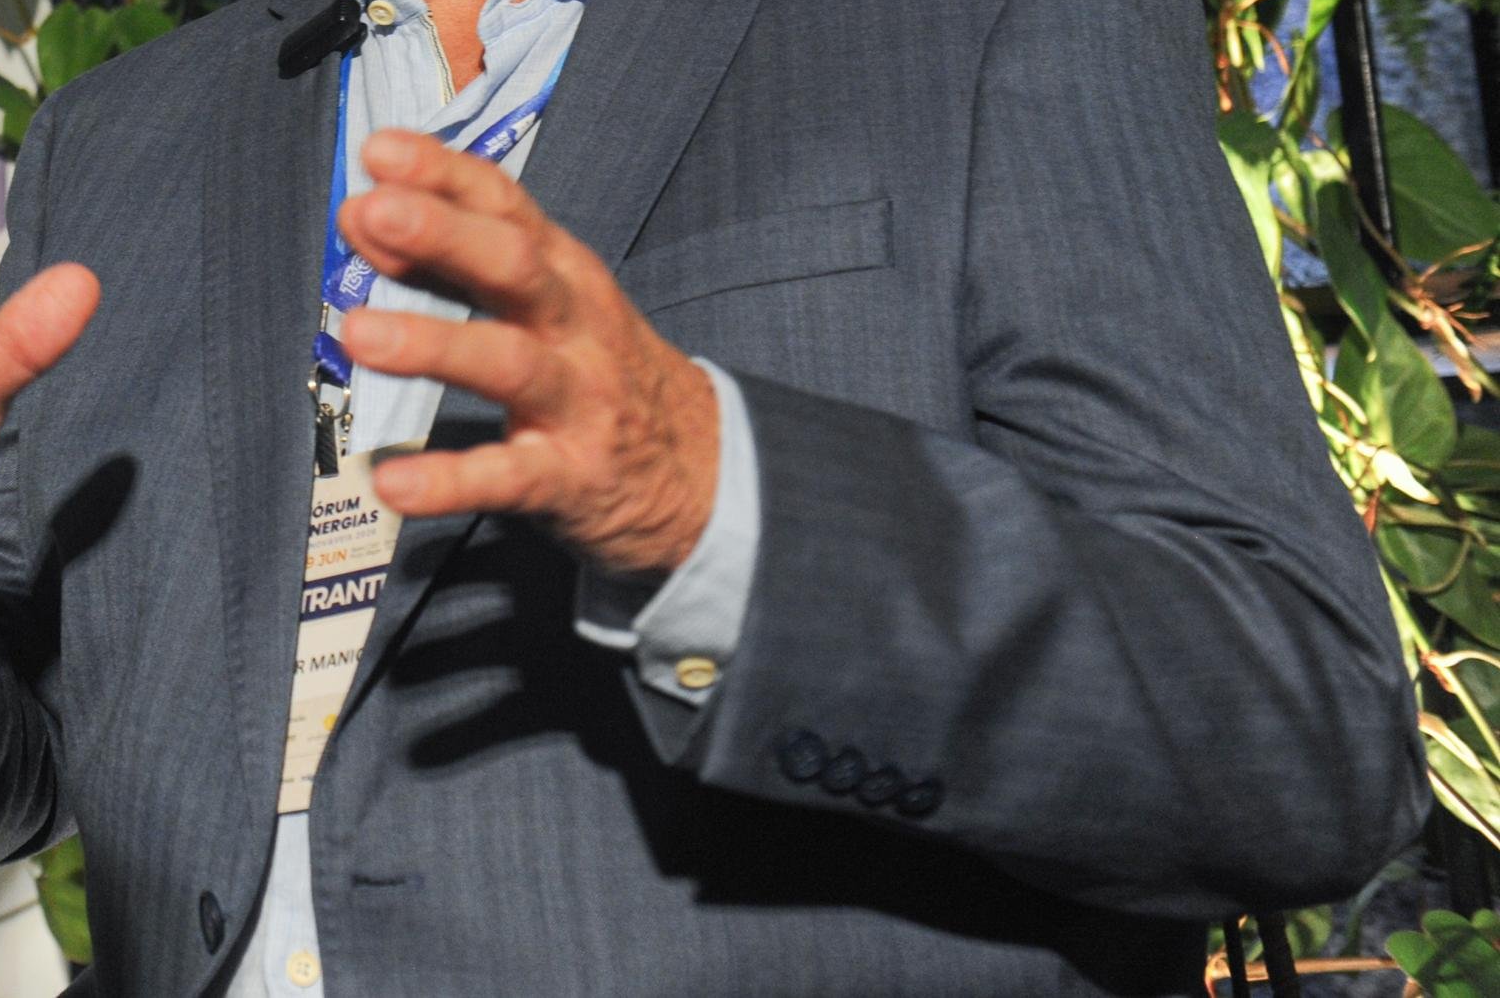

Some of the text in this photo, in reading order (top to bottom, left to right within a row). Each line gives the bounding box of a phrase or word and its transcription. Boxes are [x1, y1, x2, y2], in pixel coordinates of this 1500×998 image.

[311, 496, 361, 519] ÓRUM
[308, 509, 379, 537] NERGIAS
[301, 573, 387, 613] TRANT
